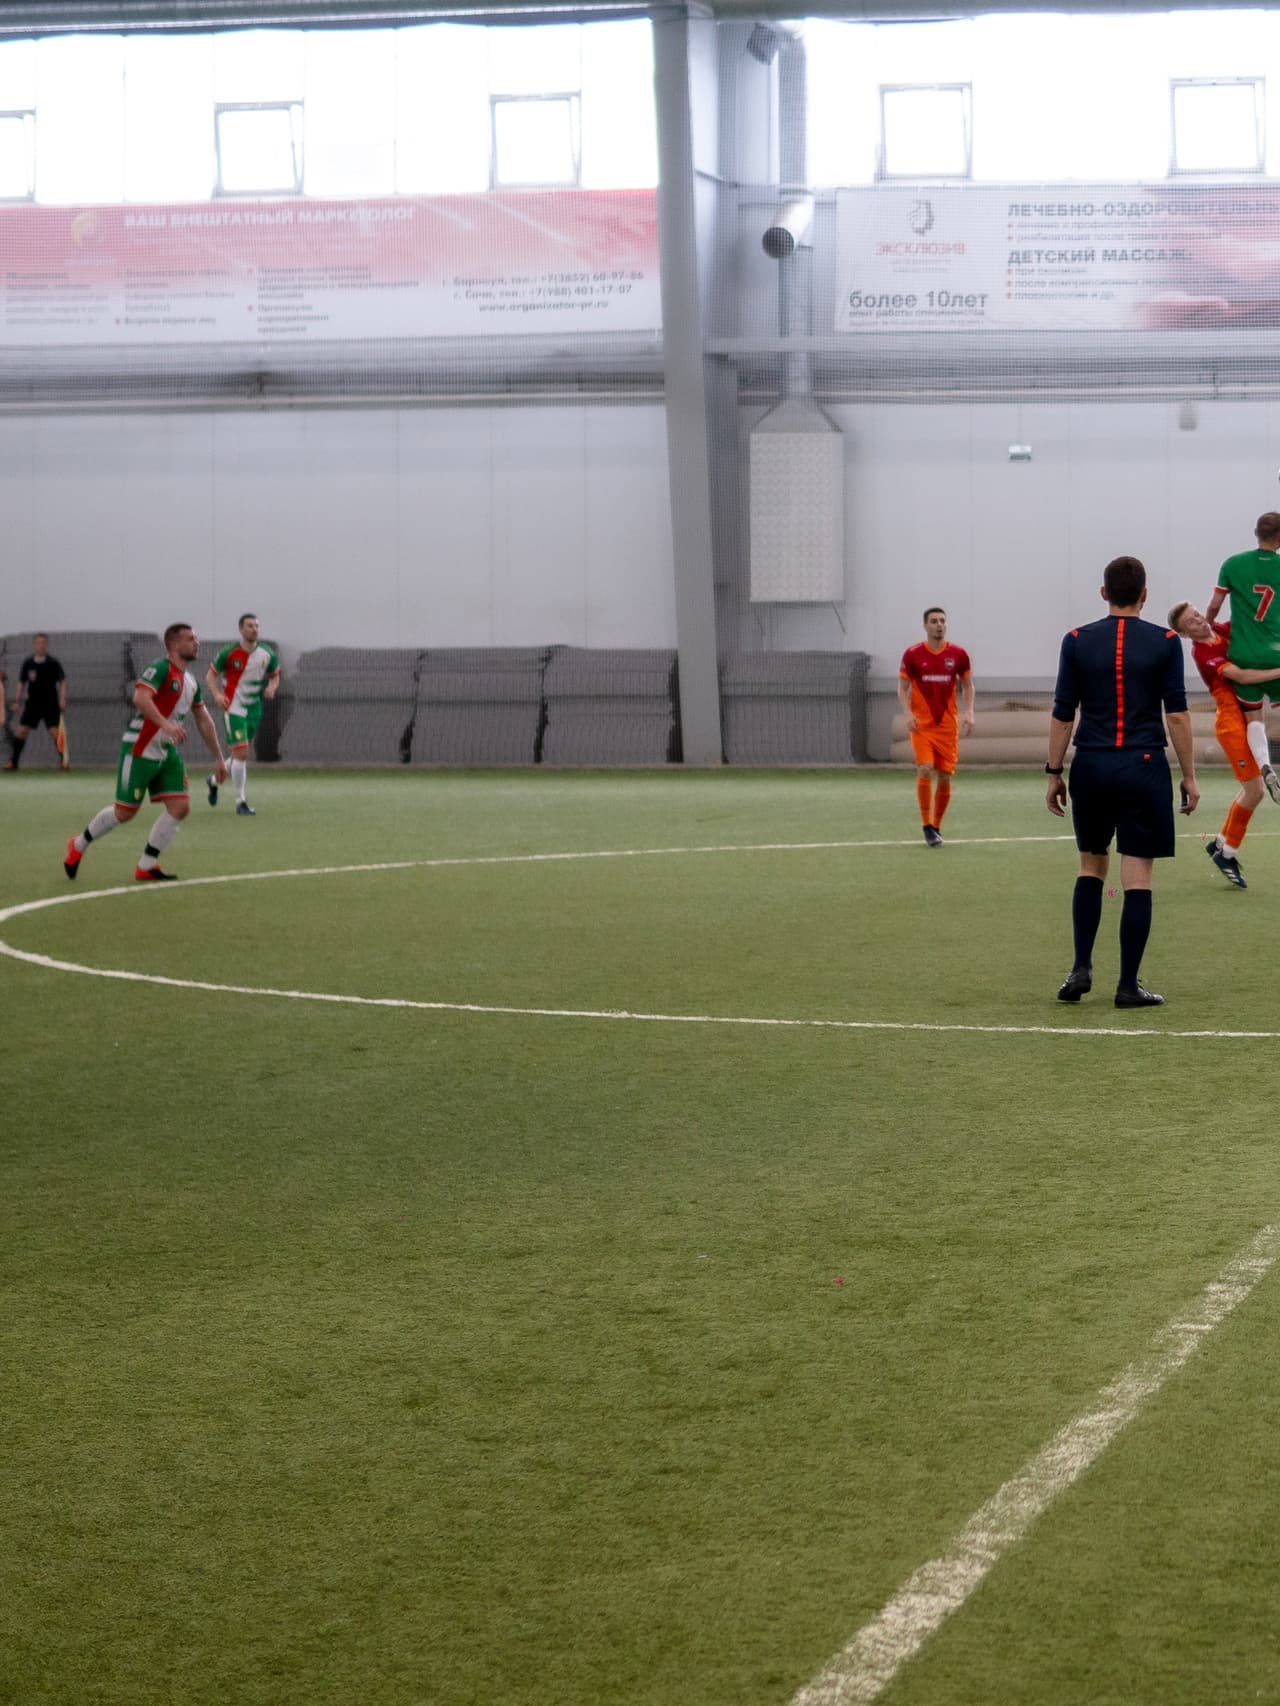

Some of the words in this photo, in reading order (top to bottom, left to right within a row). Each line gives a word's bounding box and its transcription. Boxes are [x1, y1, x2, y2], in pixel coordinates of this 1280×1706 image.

[124, 213, 167, 228] ВАШ
[170, 209, 293, 227] ВНЕШТАТНЫЙ
[875, 241, 967, 256] ЭКСКЛЮЗИВ
[1007, 247, 1096, 265] ДЕТСКИЙ
[848, 290, 918, 309] более
[925, 290, 989, 308] 10лет
[1252, 584, 1275, 622] 7
